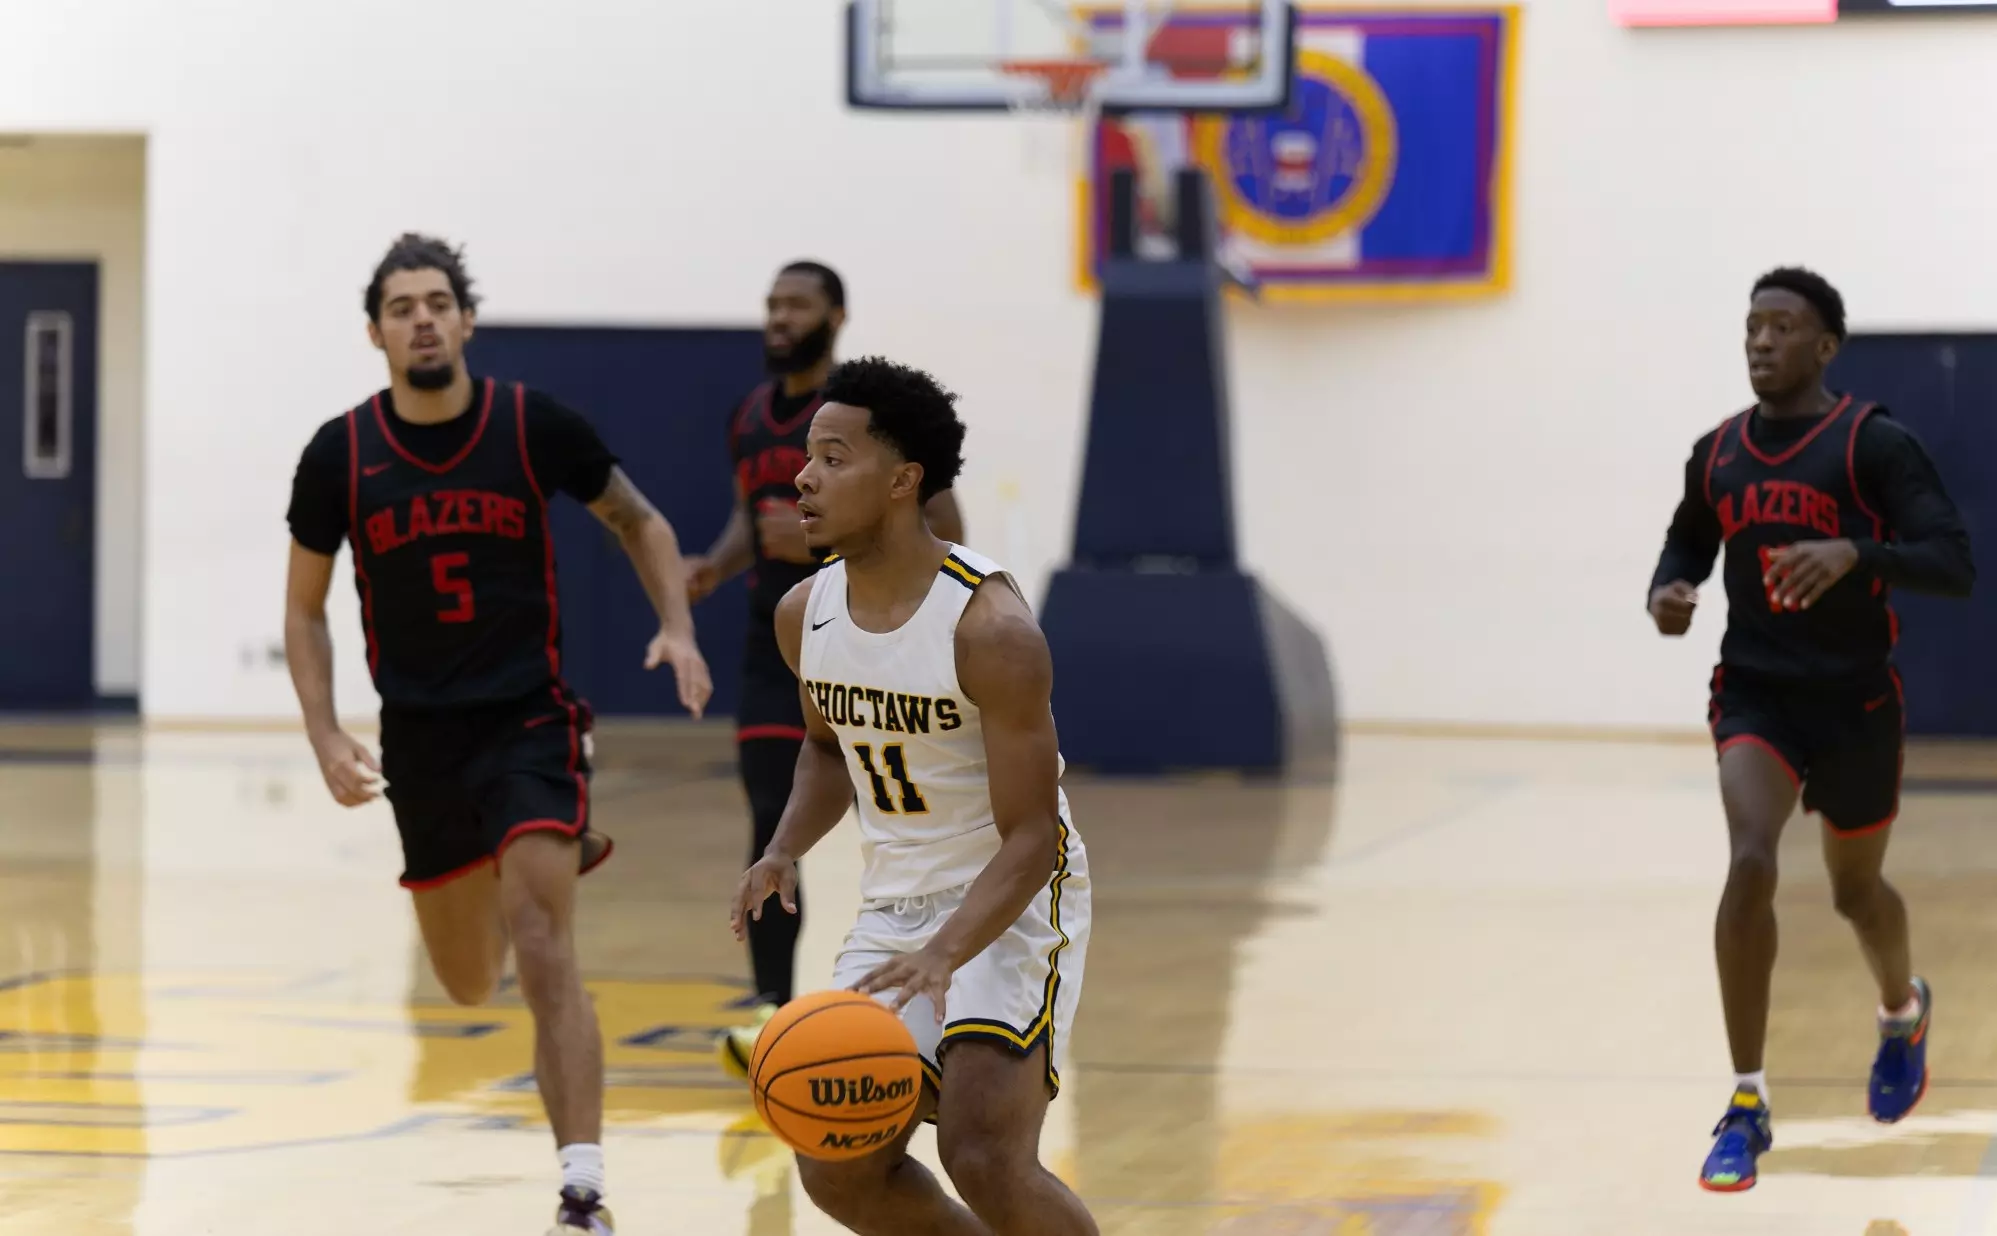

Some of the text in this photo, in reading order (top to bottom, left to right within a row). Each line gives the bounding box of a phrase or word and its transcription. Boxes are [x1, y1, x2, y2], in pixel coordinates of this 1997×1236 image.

[365, 490, 526, 555] BLAZERS
[1717, 480, 1839, 541] LAZERS
[431, 553, 475, 623] 5
[853, 742, 930, 815] 11
[808, 1074, 914, 1106] Wilson
